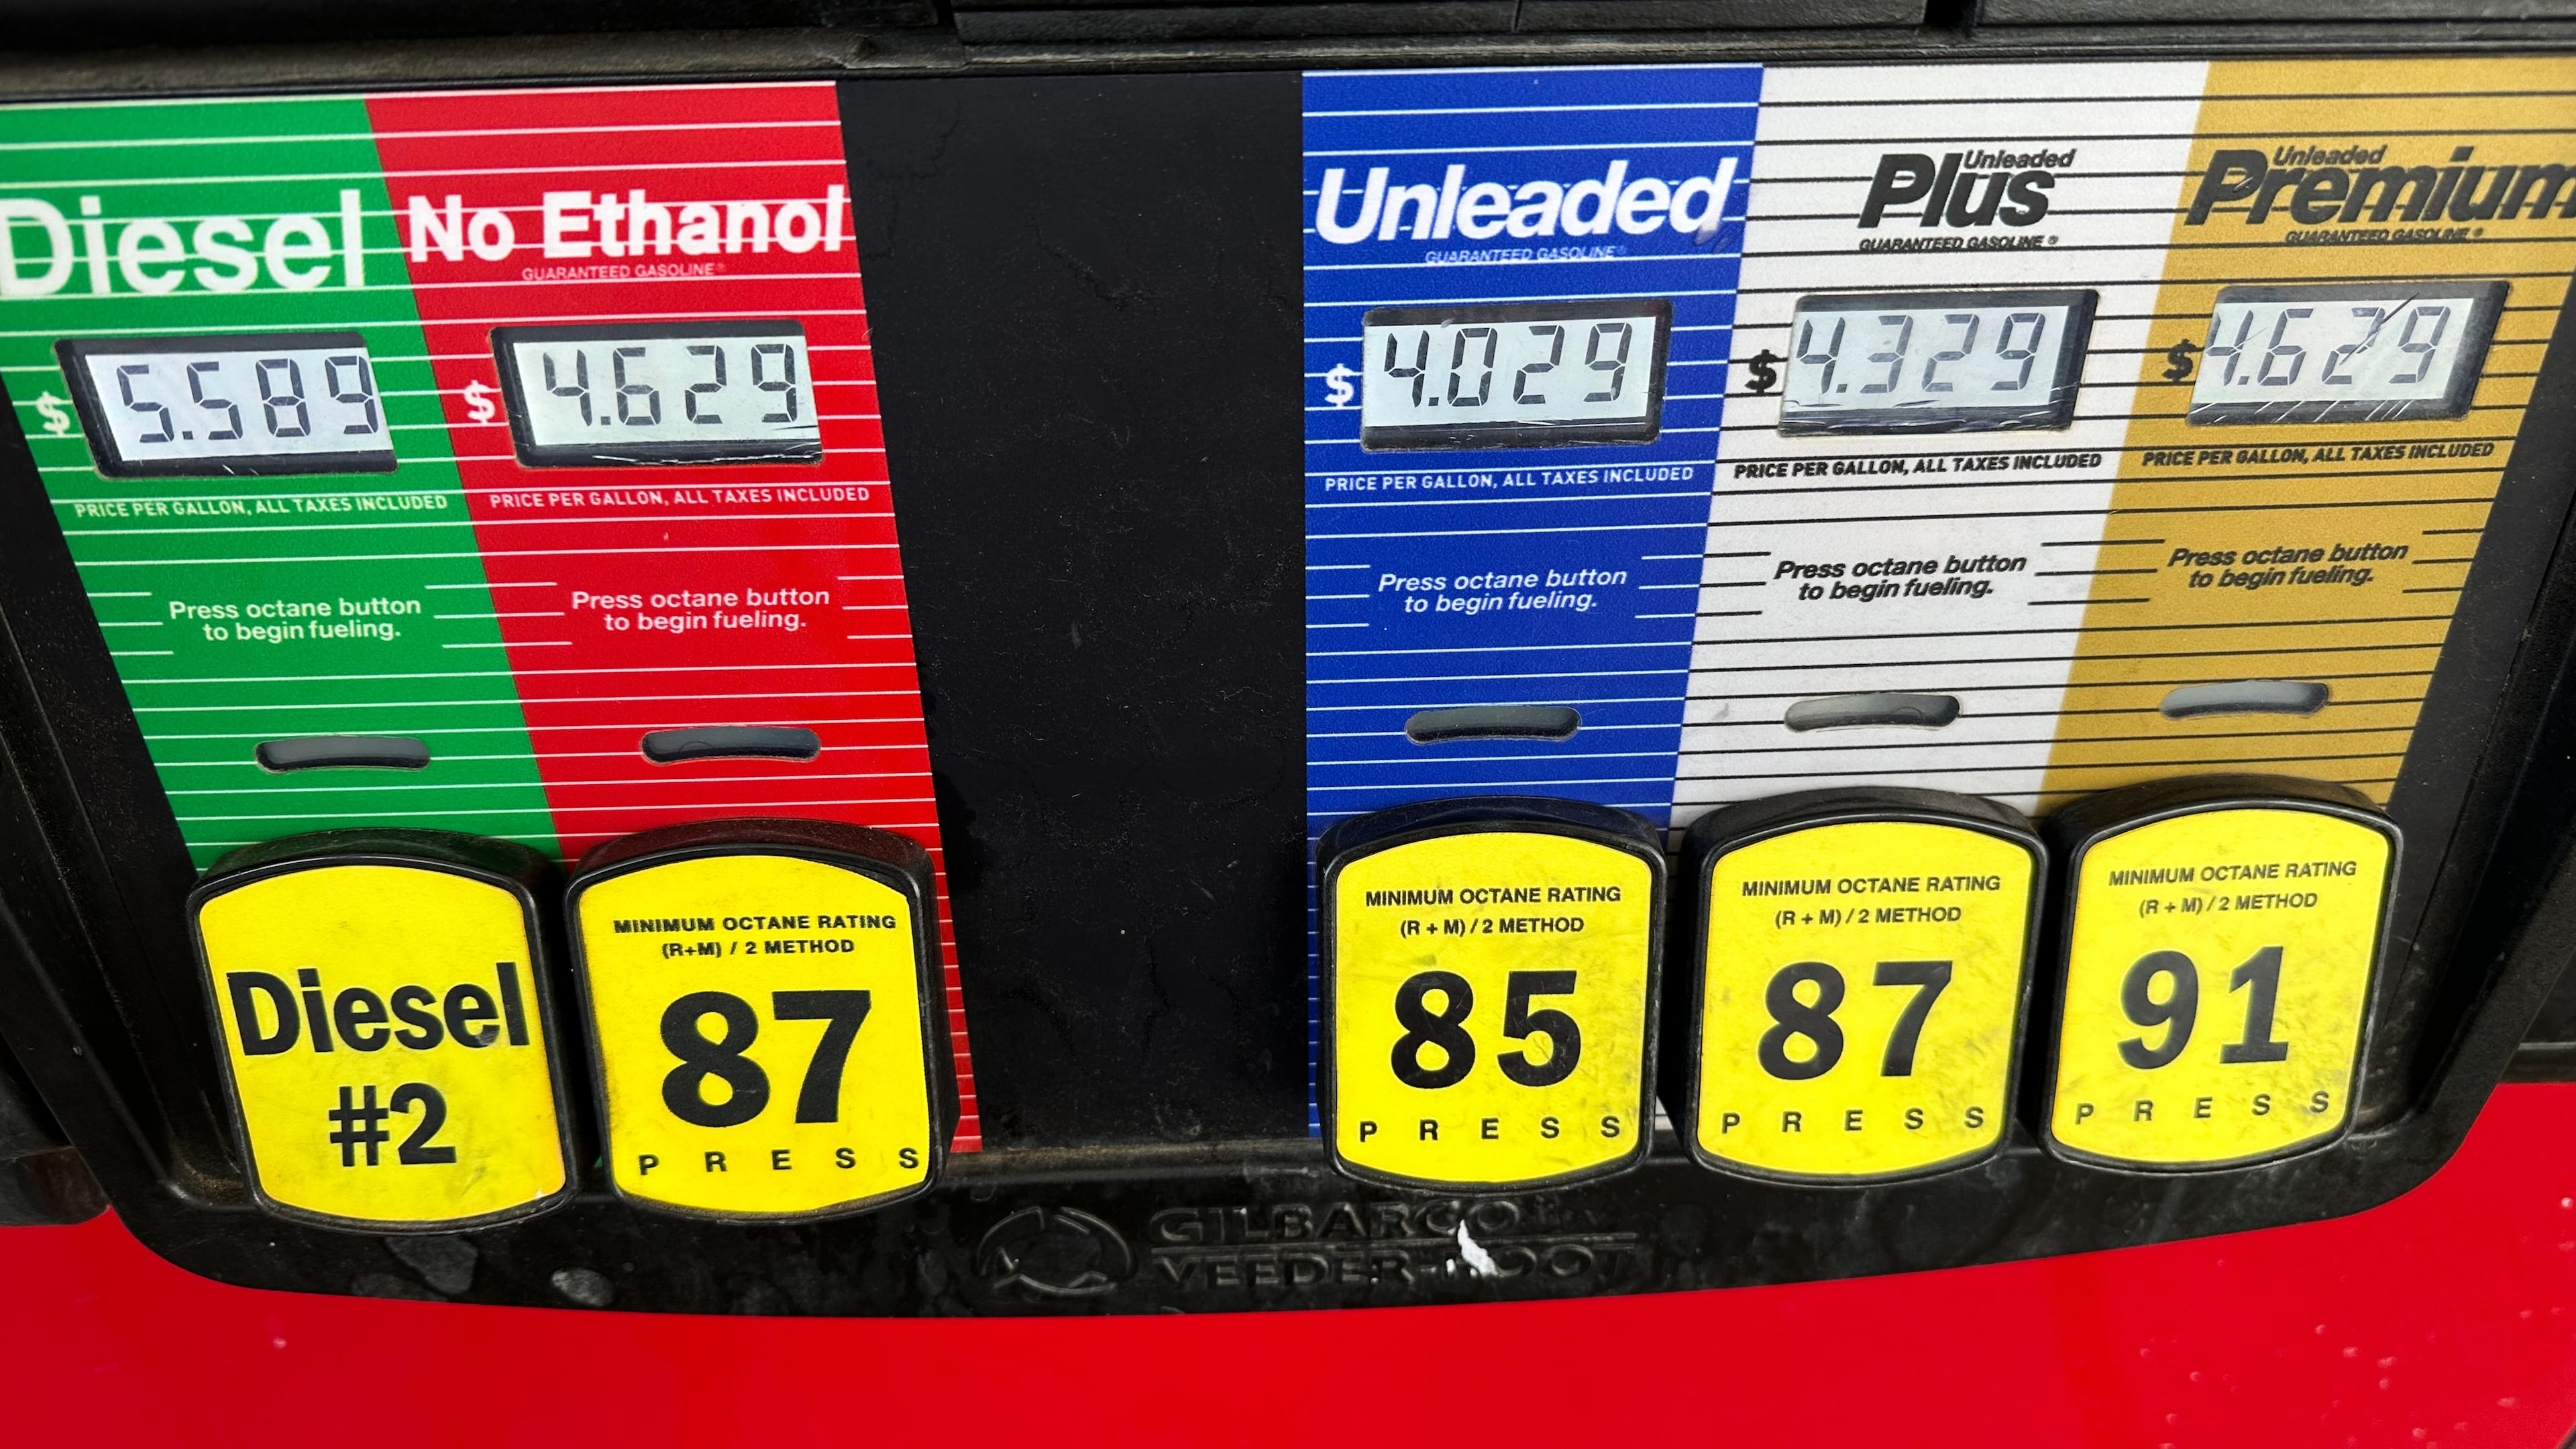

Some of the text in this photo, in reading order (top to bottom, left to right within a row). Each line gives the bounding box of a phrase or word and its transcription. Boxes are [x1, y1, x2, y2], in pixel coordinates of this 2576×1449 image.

[1964, 148, 2076, 168] Unleaded
[2273, 145, 2387, 166] Unleaded
[1857, 153, 2055, 228] Plus
[2184, 146, 2576, 225] Premium
[1316, 157, 1737, 244] Unleaded
[409, 184, 844, 262] No Ethanol
[0, 189, 365, 296] Diesel
[1859, 237, 1963, 251] GUARANTEED
[2286, 230, 2389, 244] GUARANTEED
[1425, 248, 1532, 264] GUARANTEED
[522, 265, 631, 282] GUARANTEED
[1746, 313, 2045, 395] $ 4.329
[2163, 305, 2451, 386] $ 4.629
[1326, 323, 1632, 408] $ 4.029
[464, 343, 798, 426] $ 4.629
[37, 355, 378, 443] $ 5.589
[1733, 453, 2102, 479] PRICE PER GALLON, ALL TAXES INCLUDED
[2142, 443, 2494, 466] PRICE PER GALLON, ALL TAXES INCLUDED
[1325, 468, 1694, 492] PRICE PER GALLON, ALL TAXES INCLUDED
[74, 495, 447, 518] PRICE PER GALLON, ALL TAXES INCLUDED
[490, 487, 869, 508] PRICE PER GALLON, ALL TAXES INCLUDED
[2167, 543, 2408, 567] Press octane button
[1774, 555, 2026, 580] Press octane button
[2188, 566, 2373, 590] to begin fueling.
[1379, 569, 1626, 592] Press octane button
[1799, 577, 1994, 603] to begin fueling.
[169, 597, 421, 619] Press octane button
[572, 587, 830, 610] Press octane button
[1405, 590, 1597, 615] to begin fueling.
[203, 620, 400, 643] to begin fueling.
[604, 610, 806, 634] to begin fueling.
[2108, 861, 2357, 886] MINIMUM OCTANE RATING
[1366, 886, 1621, 906] MINIMUM OCTANE RATING
[1741, 875, 2000, 897] MINIMUM OCTANE RATING
[2218, 897, 2229, 911] 2
[2235, 893, 2318, 910] METHOD
[614, 915, 896, 933] MINIMUM OCTANE RATING
[1483, 919, 1493, 934] 2
[1499, 917, 1584, 933] METHOD
[1858, 910, 1869, 924] 2
[1876, 906, 1961, 923] METHOD
[662, 943, 721, 959] (R+M)
[745, 941, 756, 955] 2
[765, 940, 855, 955] METHOD
[227, 962, 530, 1057] Diesel
[2117, 946, 2288, 1069] 91
[1391, 970, 1581, 1089] 85
[1758, 960, 1953, 1080] 87
[660, 989, 871, 1128] 87
[329, 1082, 456, 1168] #2
[1150, 1200, 1519, 1241] GILBARCO
